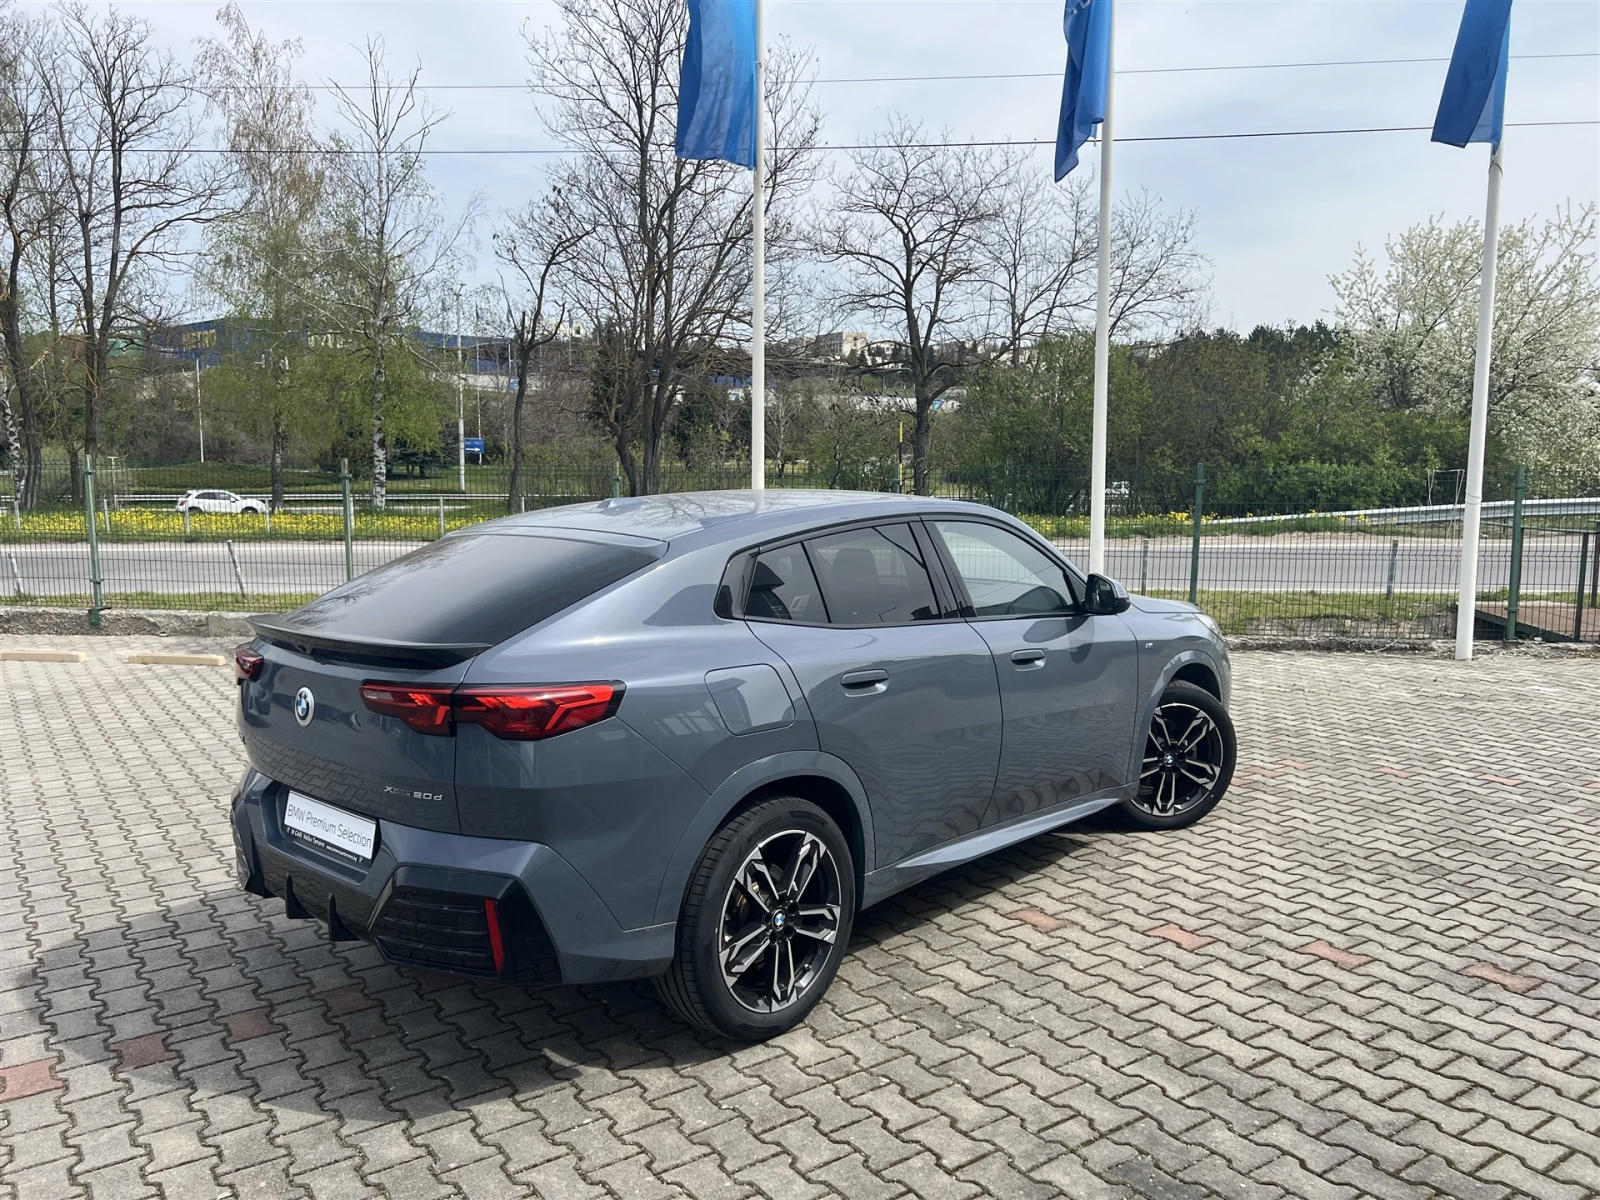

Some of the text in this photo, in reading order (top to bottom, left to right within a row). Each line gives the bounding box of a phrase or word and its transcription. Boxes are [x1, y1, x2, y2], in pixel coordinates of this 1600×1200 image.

[287, 804, 372, 849] BMW Premium Selection
